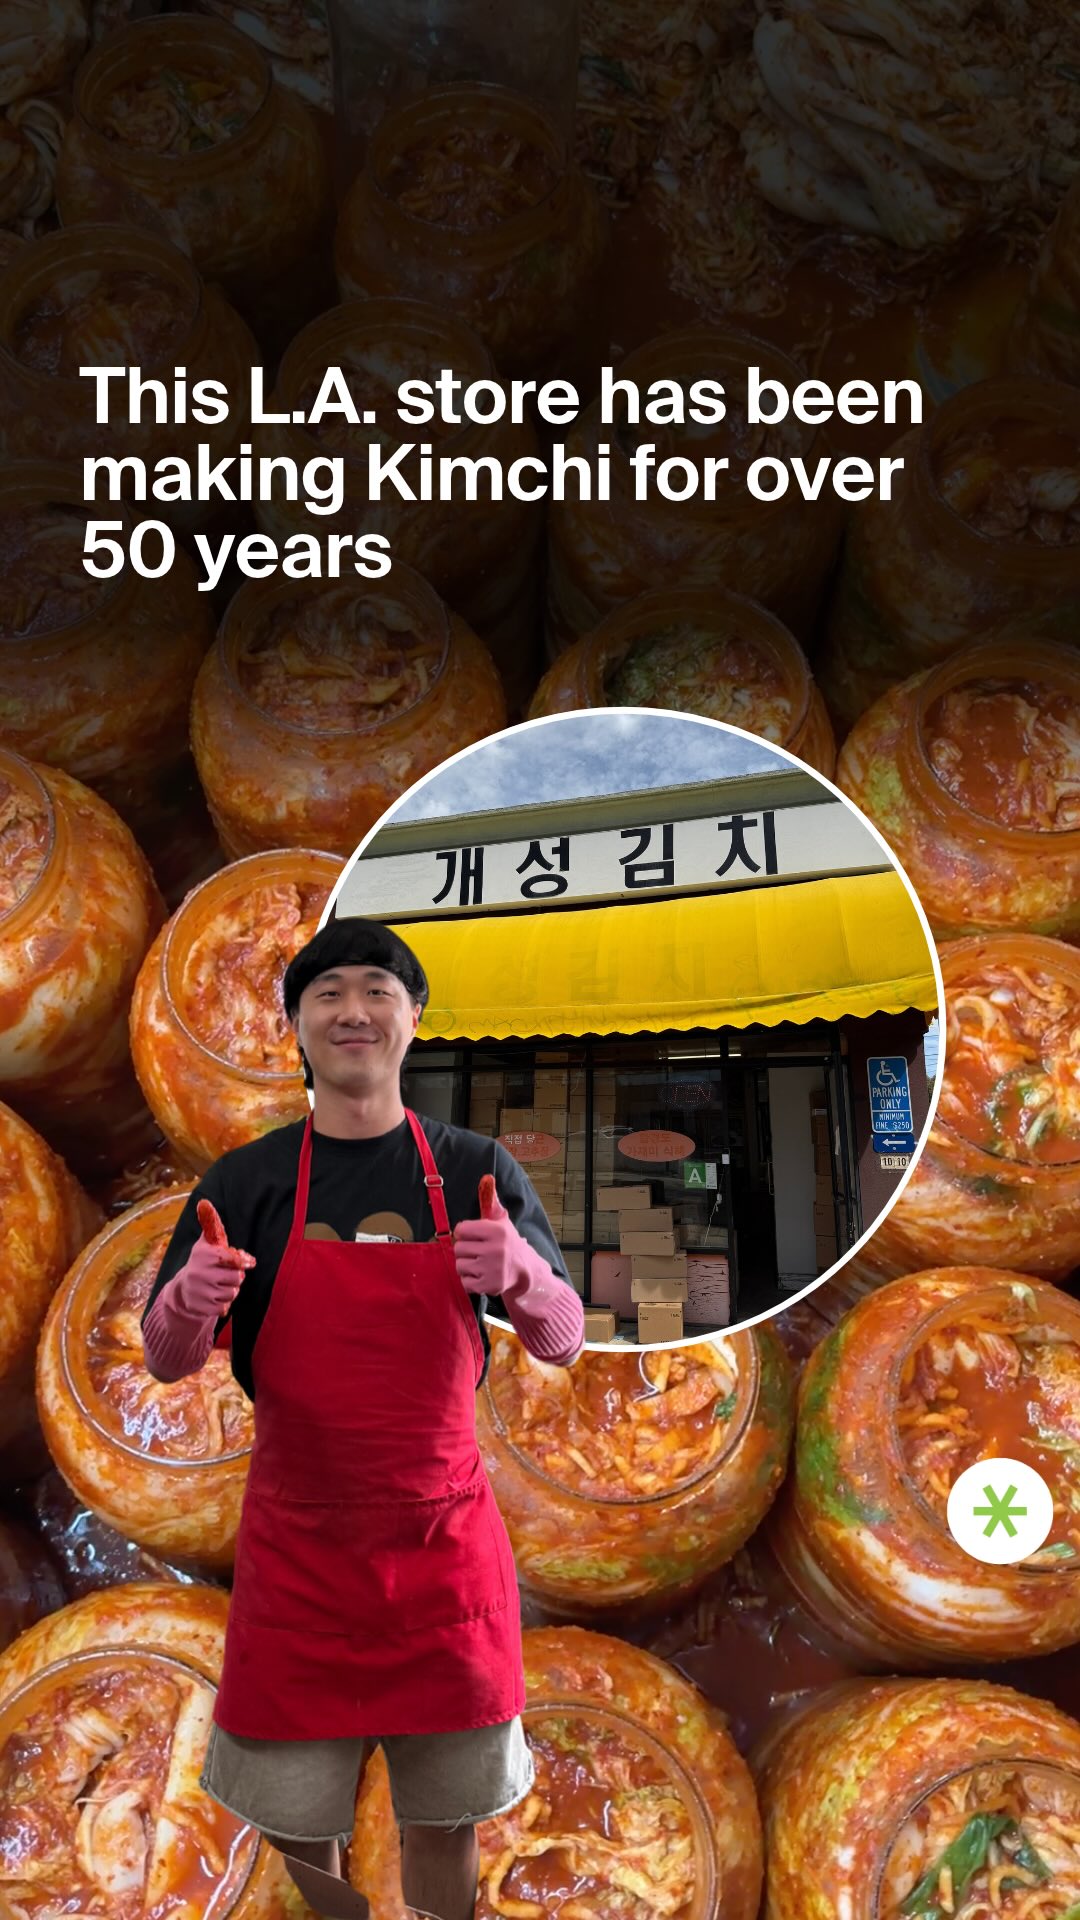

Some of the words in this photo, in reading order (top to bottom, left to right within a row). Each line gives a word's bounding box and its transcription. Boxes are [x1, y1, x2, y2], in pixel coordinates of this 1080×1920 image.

[872, 1086, 908, 1098] PARKING
[880, 1098, 901, 1109] ONLY
[879, 1112, 905, 1120] MINIMUM
[875, 1121, 888, 1129] FINE
[892, 1121, 910, 1129] $250
[688, 1167, 702, 1183] A
